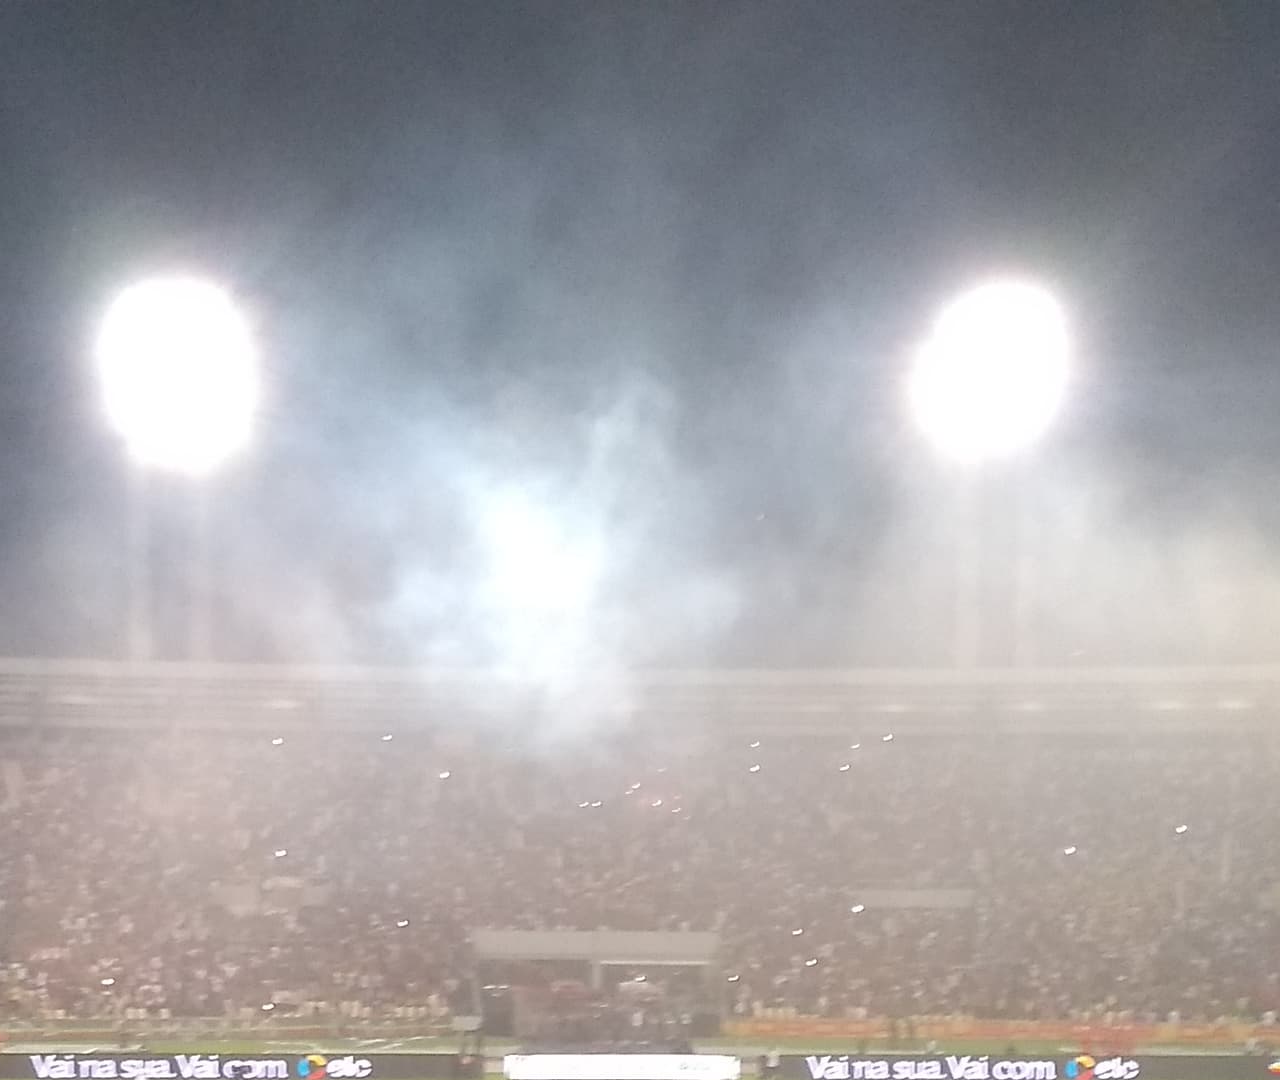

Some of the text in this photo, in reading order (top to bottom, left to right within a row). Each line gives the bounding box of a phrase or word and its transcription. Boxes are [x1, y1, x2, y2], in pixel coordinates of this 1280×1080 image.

[30, 1055, 76, 1078] Vai
[78, 1059, 118, 1078] na
[175, 1055, 220, 1078] Vai
[806, 1056, 850, 1080] Vai
[852, 1060, 889, 1080] na
[945, 1056, 990, 1080] Vai
[992, 1060, 1057, 1080] com
